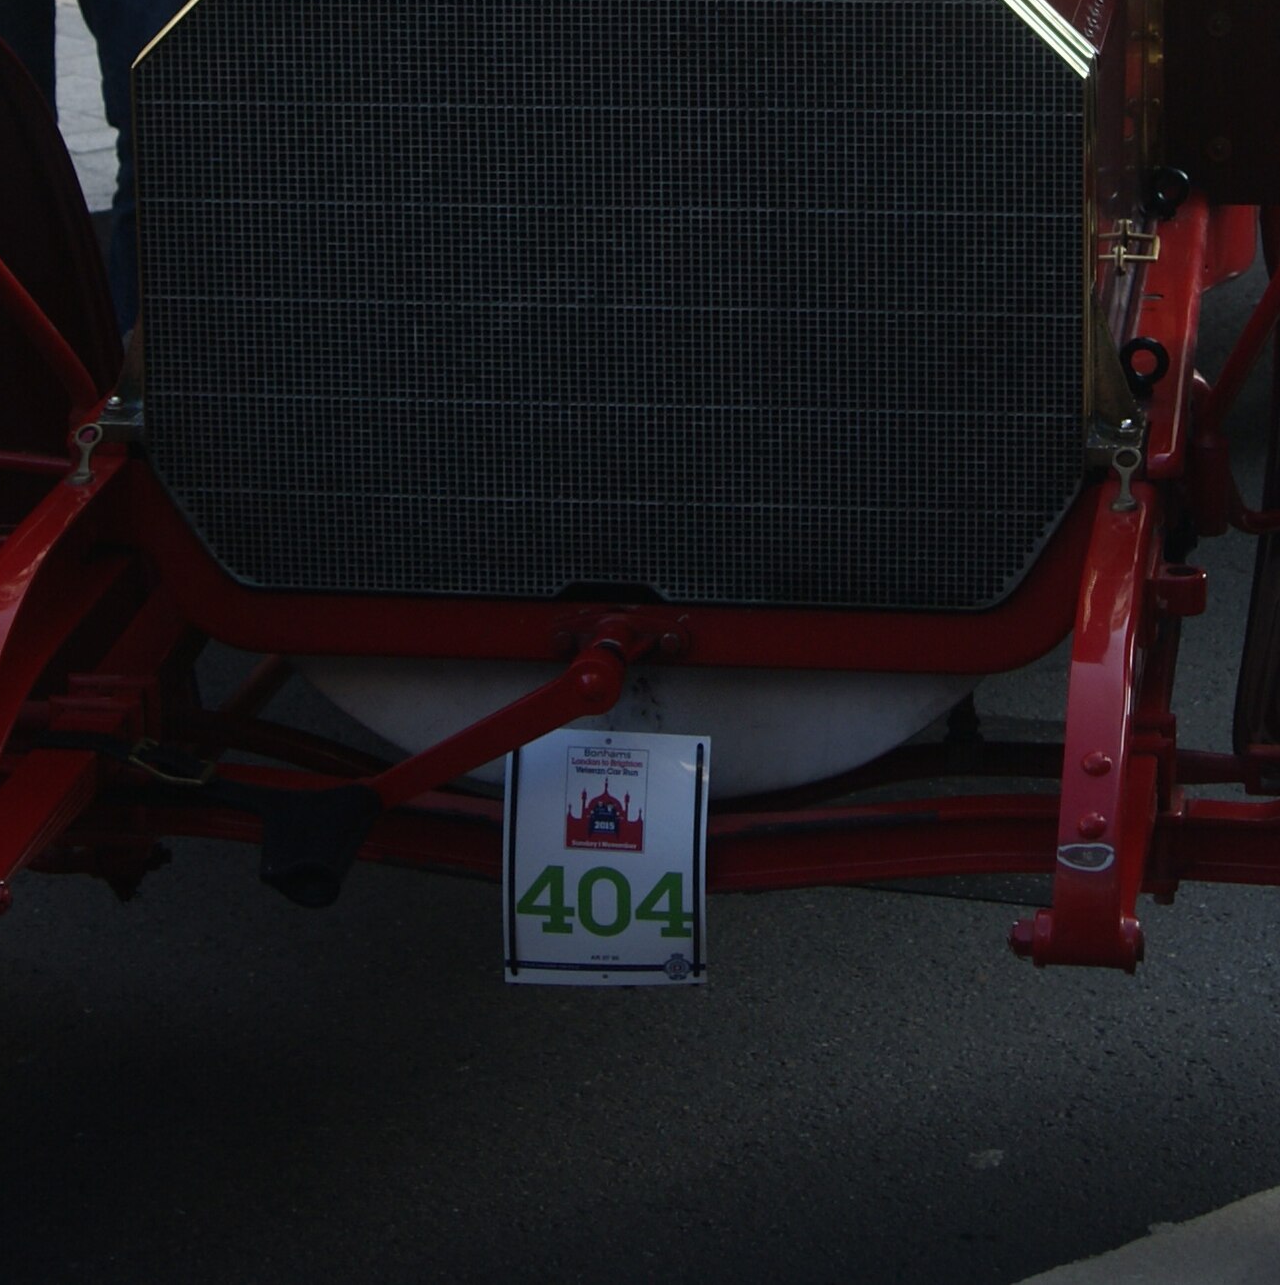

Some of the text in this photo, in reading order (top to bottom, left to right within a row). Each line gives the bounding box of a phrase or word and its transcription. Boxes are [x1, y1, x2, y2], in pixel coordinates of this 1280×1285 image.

[584, 748, 631, 759] Bonhams
[571, 757, 599, 765] London
[610, 759, 643, 768] Brighton
[576, 766, 638, 776] Veteran Car Run
[516, 865, 694, 938] 404
